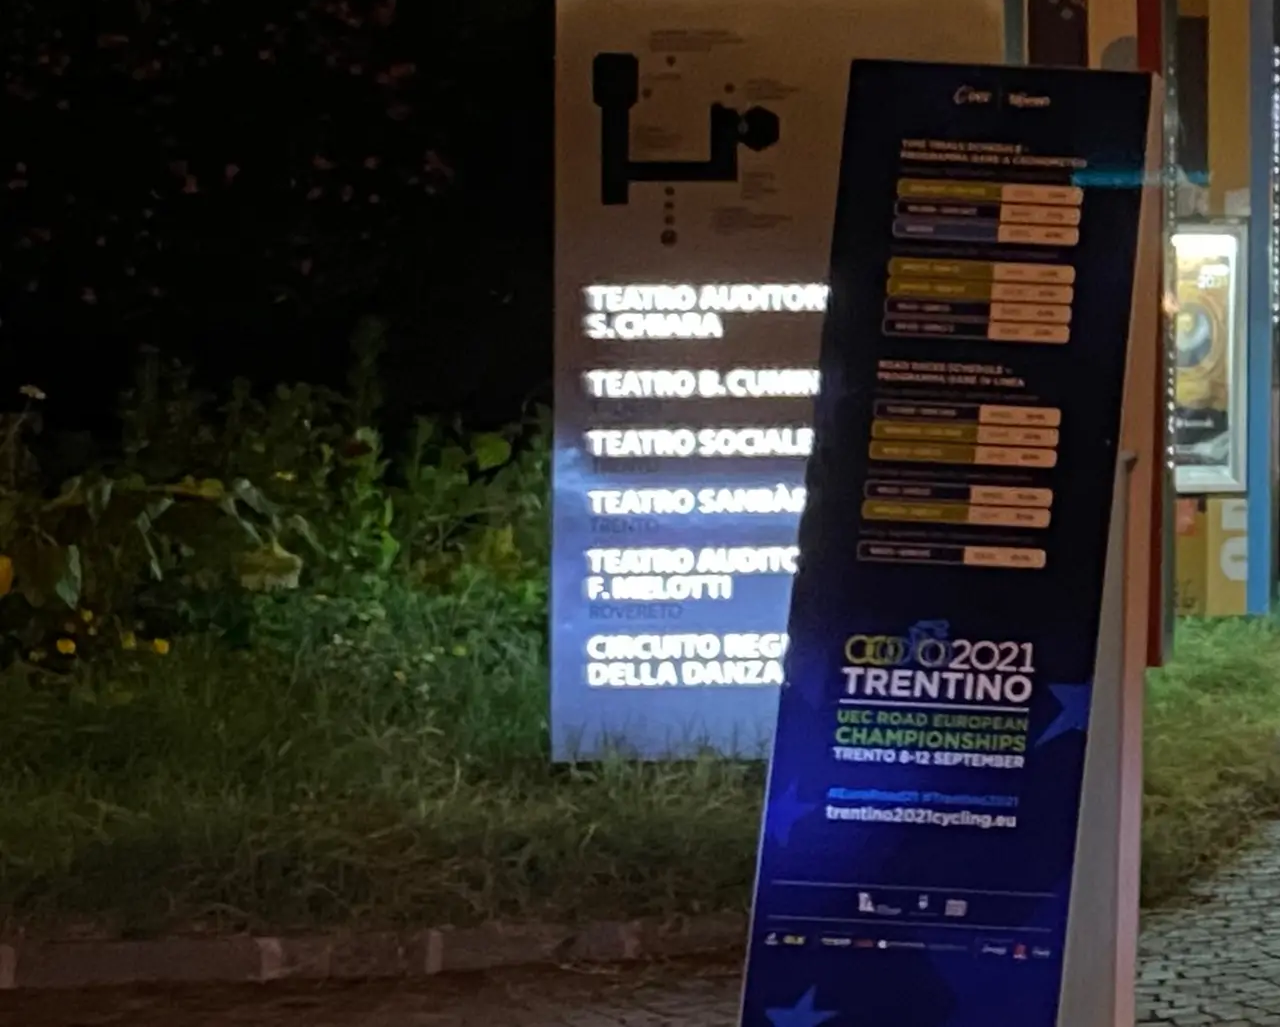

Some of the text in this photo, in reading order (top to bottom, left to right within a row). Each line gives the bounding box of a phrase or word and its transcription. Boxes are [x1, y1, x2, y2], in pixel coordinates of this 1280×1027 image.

[585, 285, 697, 311] TEATRO
[585, 370, 696, 397] TEATRO
[586, 428, 815, 455] TEATRO SOCIALE
[587, 489, 696, 514] TEATRO
[590, 517, 660, 534] TRENTO
[586, 547, 695, 574] TEATRO
[611, 576, 732, 600] MELOTTI
[588, 603, 684, 620] ROVERETO
[586, 634, 721, 660] CIRCUITO
[948, 639, 1036, 673] 2021
[587, 660, 785, 686] DELLA DANZA
[842, 667, 1033, 703] TRENTINO
[837, 709, 1028, 732] UEC ROAD EUROPEAN
[835, 727, 1027, 752] CHAMPIONSHIPS
[832, 746, 1025, 769] TRENTO 8-12 SEPTEMBER
[825, 805, 1018, 829] trentino2021cycling.eu
